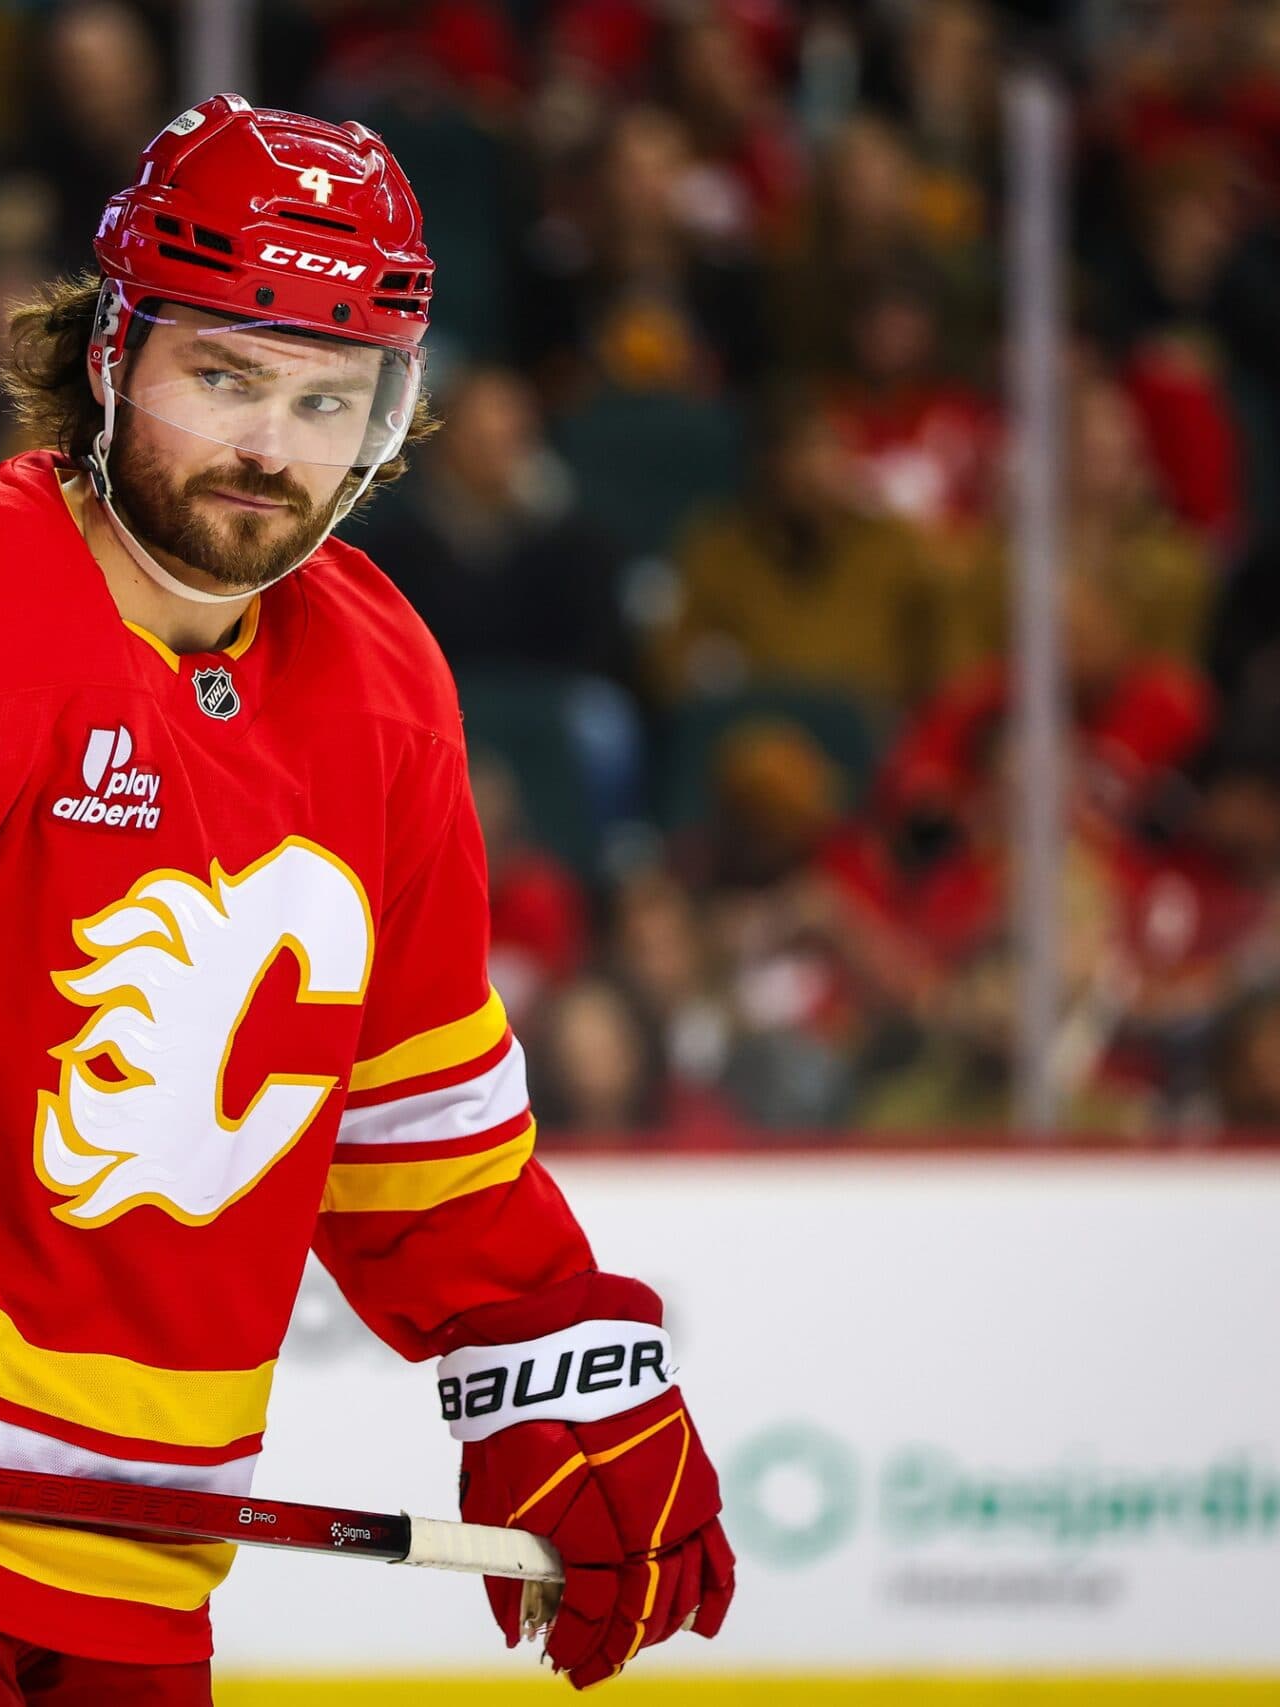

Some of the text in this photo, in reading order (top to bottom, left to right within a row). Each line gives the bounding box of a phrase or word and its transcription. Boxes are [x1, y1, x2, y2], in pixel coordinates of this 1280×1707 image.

[298, 166, 333, 206] 4
[259, 243, 368, 281] CCM
[207, 681, 227, 711] NHL
[103, 767, 160, 803] play
[52, 795, 161, 830] alberta
[437, 1340, 669, 1422] BAUER
[342, 1523, 371, 1541] sigma
